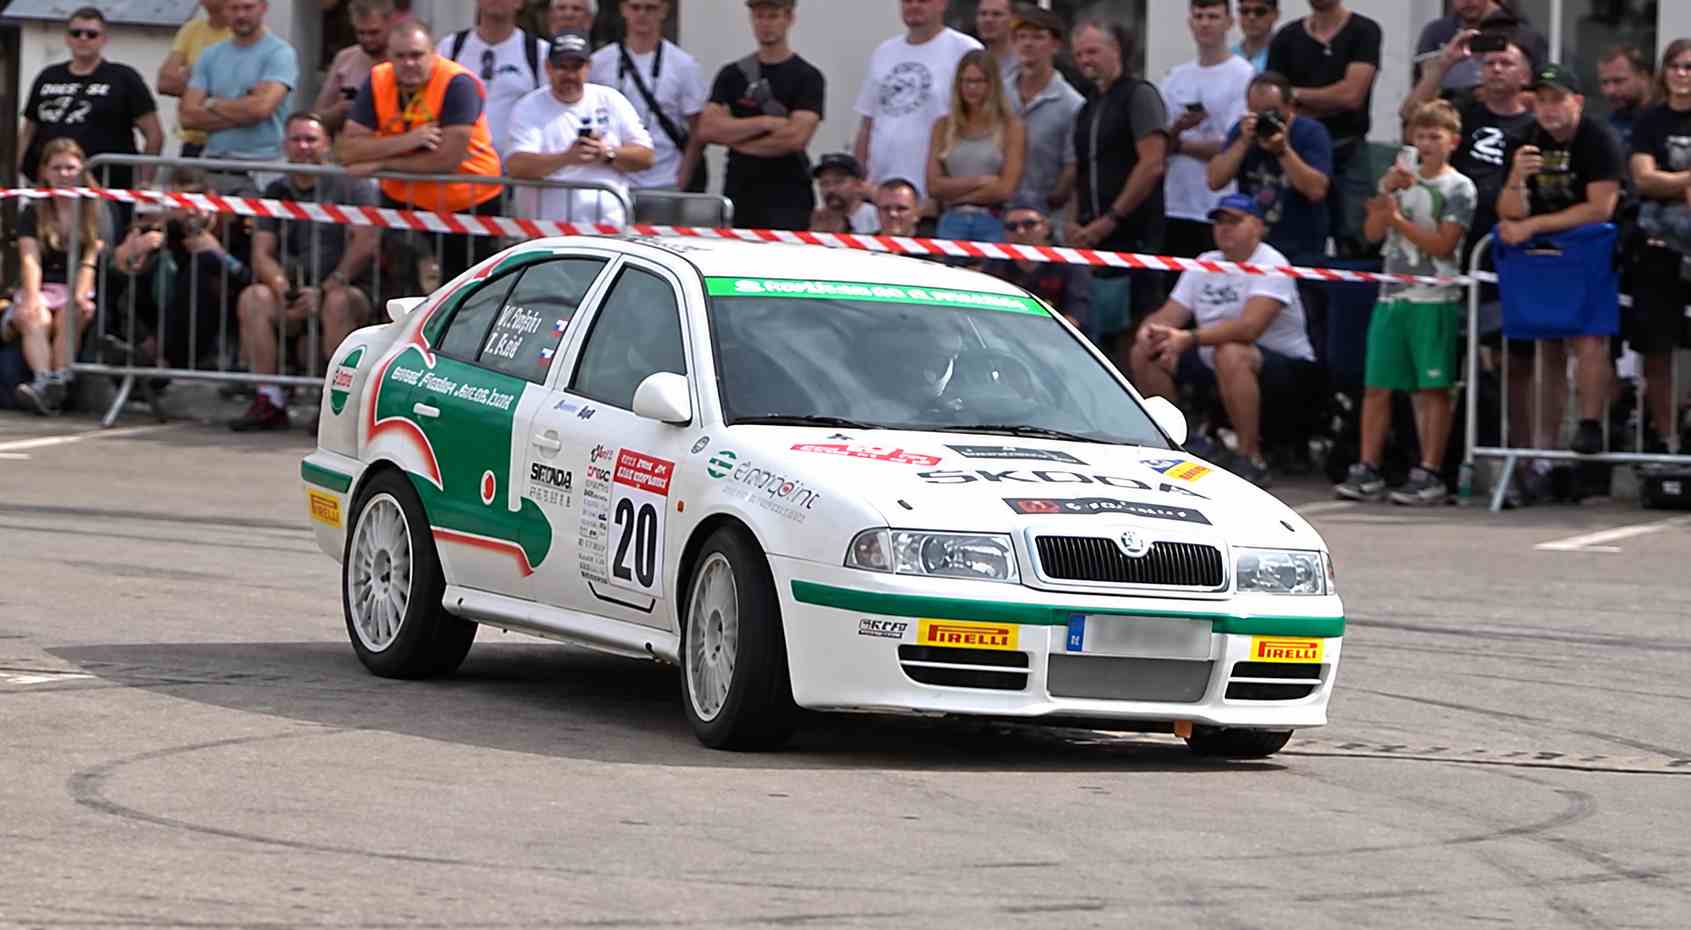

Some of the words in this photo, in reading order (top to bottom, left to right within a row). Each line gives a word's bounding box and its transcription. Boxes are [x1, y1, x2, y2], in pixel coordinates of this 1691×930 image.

[613, 497, 658, 588] 20
[928, 624, 1009, 646] PIRELLI
[1258, 640, 1318, 658] PIRELLI
